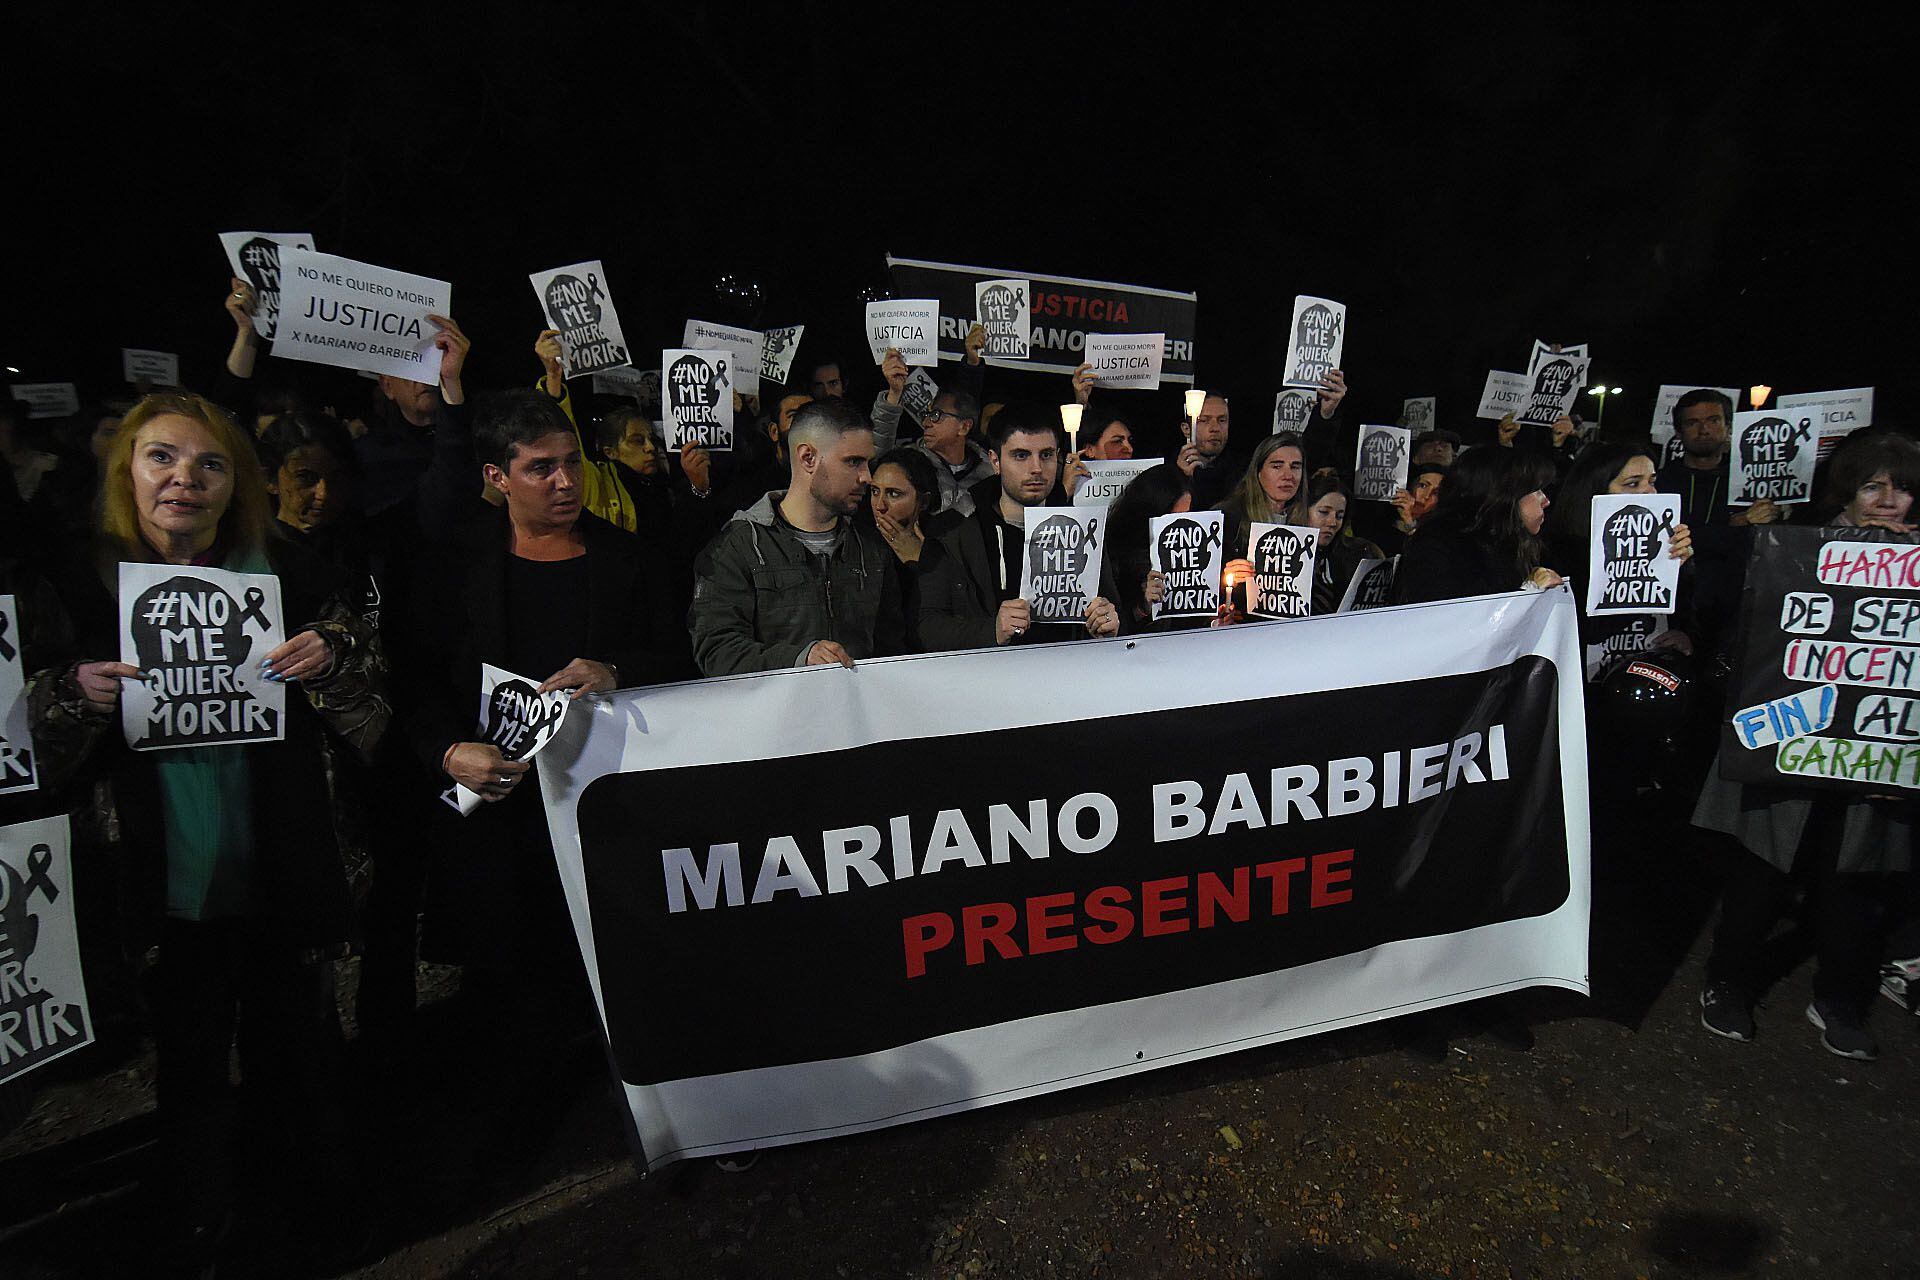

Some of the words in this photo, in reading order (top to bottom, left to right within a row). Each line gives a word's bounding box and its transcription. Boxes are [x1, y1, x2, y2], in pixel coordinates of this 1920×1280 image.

[245, 246, 280, 269] #N
[297, 266, 319, 281] NO
[322, 272, 342, 286] ME
[345, 278, 393, 298] QUIERO
[396, 289, 436, 307] MORIR
[550, 280, 587, 308] #NO
[984, 290, 1011, 306] #NO
[1030, 292, 1129, 323] USTICIA
[304, 296, 421, 339] JUSTICIA
[560, 302, 594, 327] ME
[988, 305, 1010, 320] ME
[1302, 309, 1331, 329] #NO
[874, 325, 924, 340] JUSTICIA
[1305, 328, 1328, 346] ME
[291, 330, 300, 341] X
[304, 333, 367, 352] MARIANO
[369, 344, 423, 363] BARBIERI
[567, 341, 623, 370] MORIR
[984, 336, 1025, 354] MORIR
[672, 363, 709, 384] #NO
[761, 360, 782, 380] RIR
[1095, 357, 1150, 370] JUSTICIA
[1543, 365, 1572, 380] #NO
[678, 384, 709, 404] ME
[1541, 379, 1565, 394] ME
[1282, 396, 1303, 410] #NO
[1284, 409, 1300, 420] ME
[673, 425, 729, 446] MORIR
[1745, 422, 1791, 444] #NO
[1364, 437, 1394, 452] #NO
[1752, 443, 1787, 462] ME
[1369, 452, 1391, 466] ME
[1105, 470, 1131, 478] QUIERO
[1085, 484, 1124, 498] JUSTI
[1742, 479, 1803, 499] MORIR
[1608, 513, 1653, 537] #NO
[1035, 524, 1080, 549] #NO
[1162, 526, 1203, 549] #NO
[1260, 534, 1297, 556] #NO
[1615, 536, 1649, 558] ME
[1042, 549, 1076, 573] ME
[1170, 548, 1199, 569] ME
[1264, 555, 1292, 574] ME
[1160, 589, 1216, 611] MORIR
[1600, 580, 1667, 604] MORIR
[142, 590, 230, 627] #NO
[1256, 592, 1308, 616] MORIR
[1784, 596, 1830, 630] DE
[159, 627, 228, 663] ME
[1787, 639, 1916, 688] INOCEN
[1632, 666, 1674, 687] JUSTICIA
[495, 687, 542, 727] #NO
[1858, 697, 1919, 737] AL
[142, 698, 271, 739] MORIR
[491, 715, 530, 751] ME
[661, 792, 1119, 914] MARIANO
[1152, 724, 1510, 843] BARBIERI
[902, 848, 1355, 979] PRESENTE
[0, 997, 78, 1066] RIR
